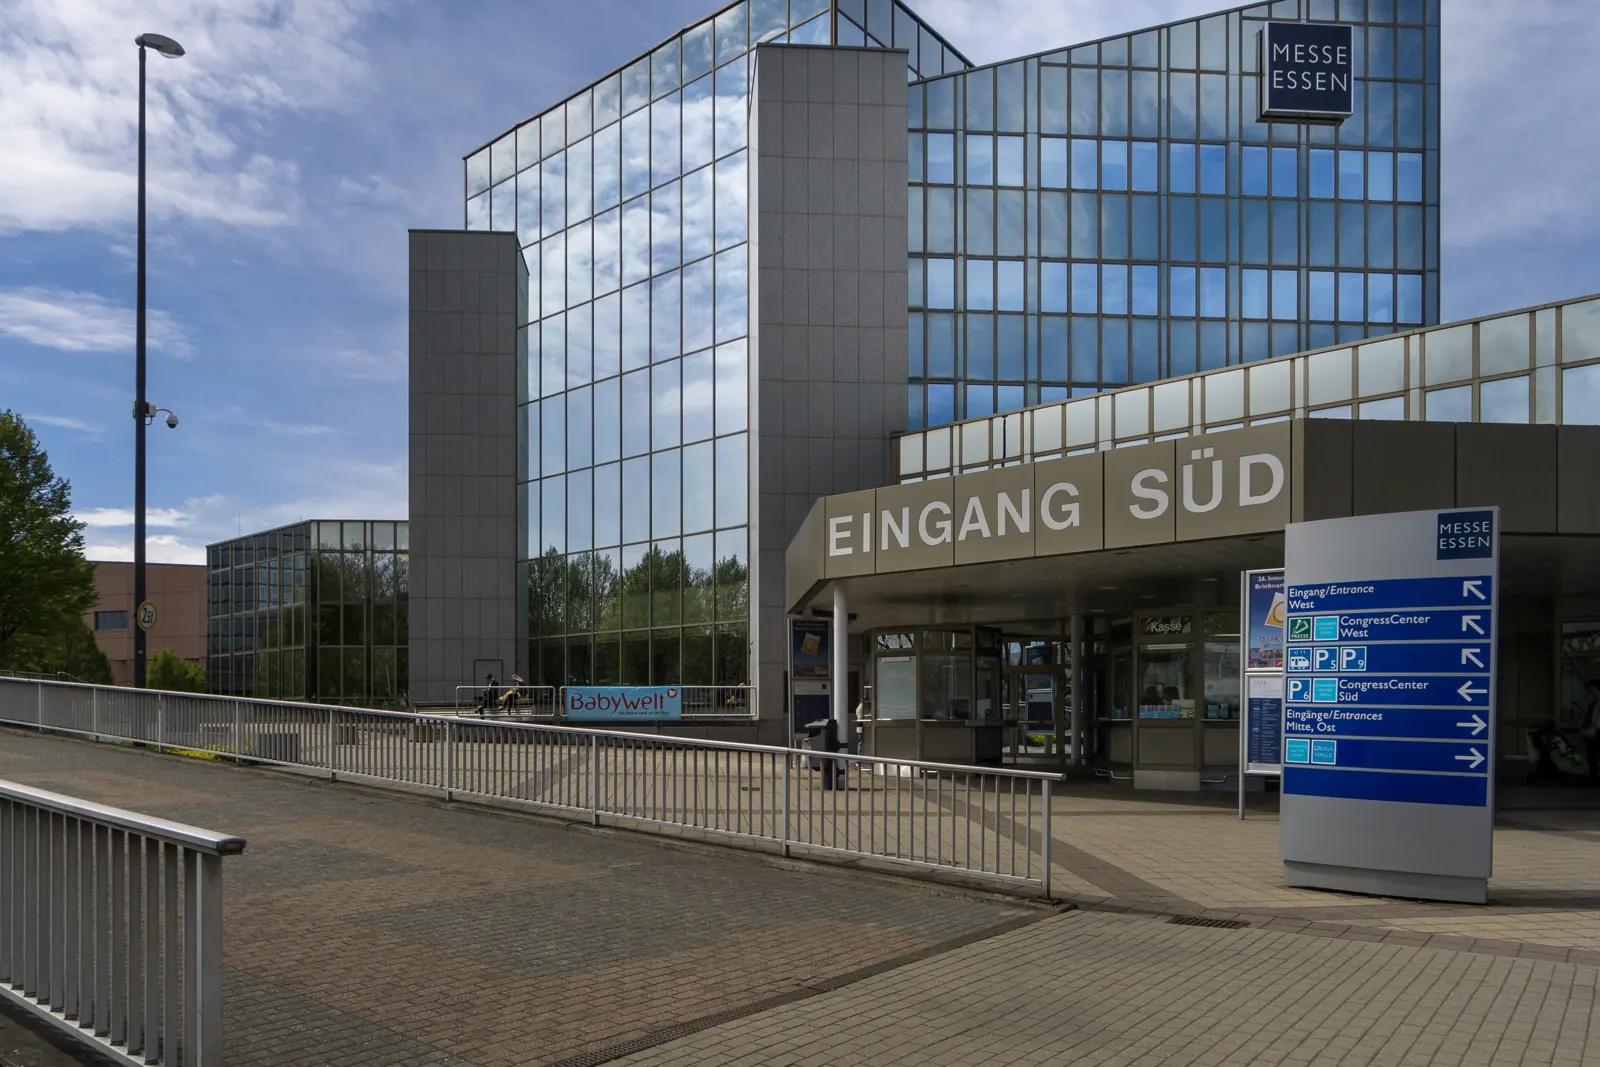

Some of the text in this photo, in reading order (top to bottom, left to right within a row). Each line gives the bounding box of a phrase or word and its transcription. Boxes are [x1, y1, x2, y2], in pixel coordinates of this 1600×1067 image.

[1273, 43, 1347, 65] MESSE
[1273, 70, 1347, 91] ESSEN
[828, 446, 1285, 557] EINGANG SÜD
[1440, 521, 1490, 534] MESSE
[1440, 536, 1490, 549] ESSEN
[1289, 585, 1375, 600] Eingang/Entrance
[1289, 599, 1315, 609] West
[1150, 620, 1182, 633] Kasse
[1340, 614, 1431, 628] CongressCenter
[1340, 628, 1369, 638] West
[1315, 649, 1337, 669] P 5
[1342, 649, 1364, 669] P 9
[1289, 680, 1302, 700] P
[1303, 692, 1310, 700] 6
[1339, 679, 1429, 692] CongressCenter
[1339, 691, 1359, 701] Süd
[1286, 709, 1383, 722] Eingänge/Entrances
[1286, 721, 1336, 733] Mitte, Ost
